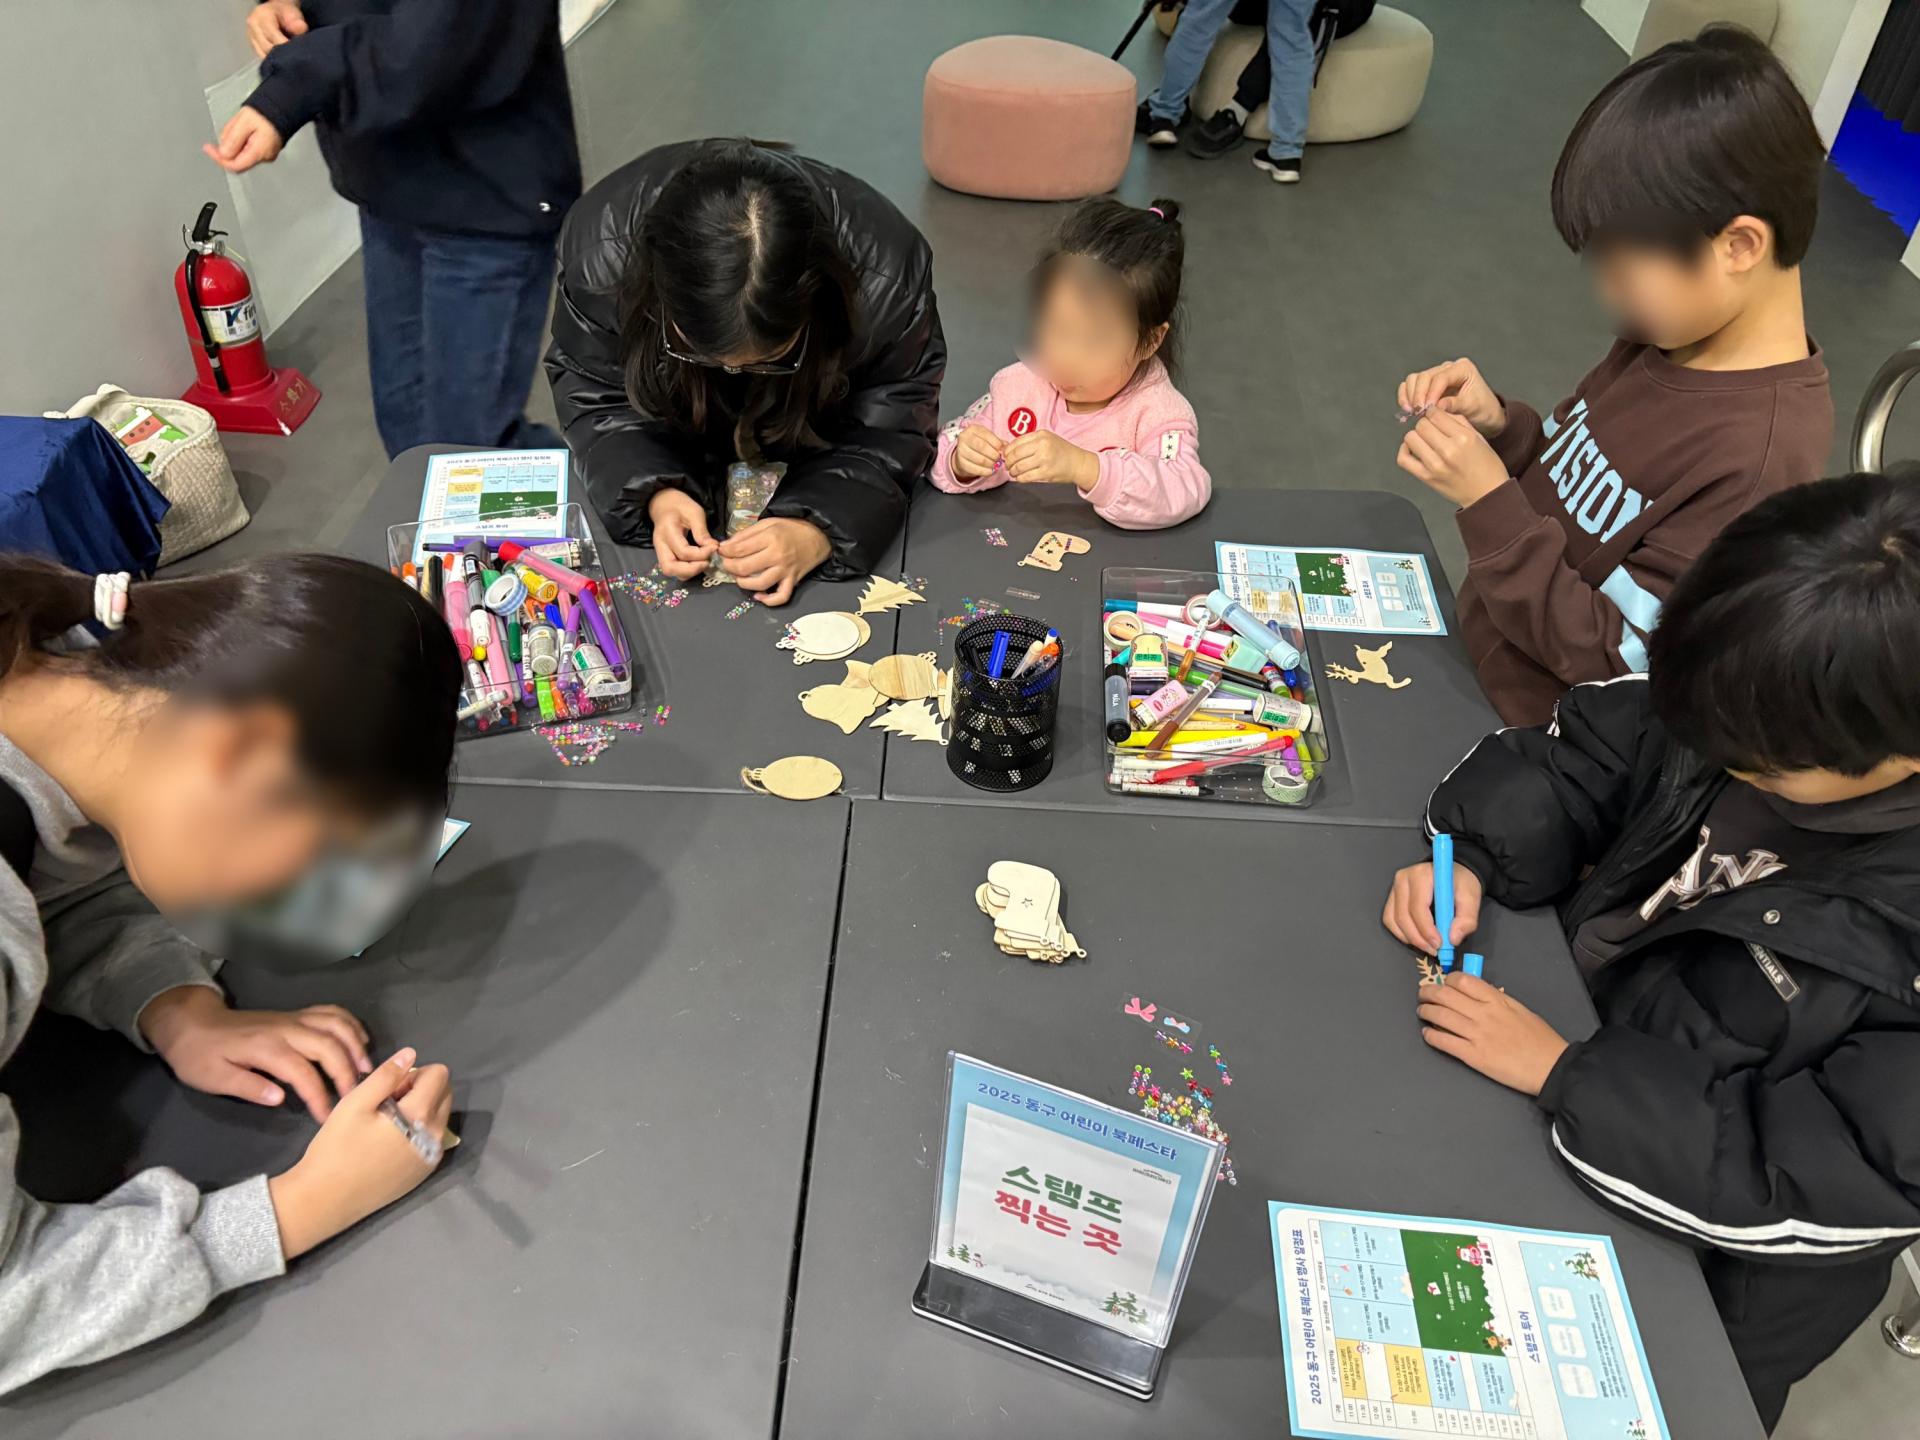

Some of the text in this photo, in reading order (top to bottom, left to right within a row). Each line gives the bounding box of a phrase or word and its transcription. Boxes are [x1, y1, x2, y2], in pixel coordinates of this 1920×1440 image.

[977, 1083, 1177, 1161] 2025 동구 어린이 북페스타
[994, 1189, 1123, 1256] 찍는 곳
[1001, 1165, 1123, 1224] 스탬프
[1292, 1229, 1322, 1404] 2025 동구 어린이 북페스타 행사 일정표
[1518, 1311, 1540, 1364] 스탬프 투어
